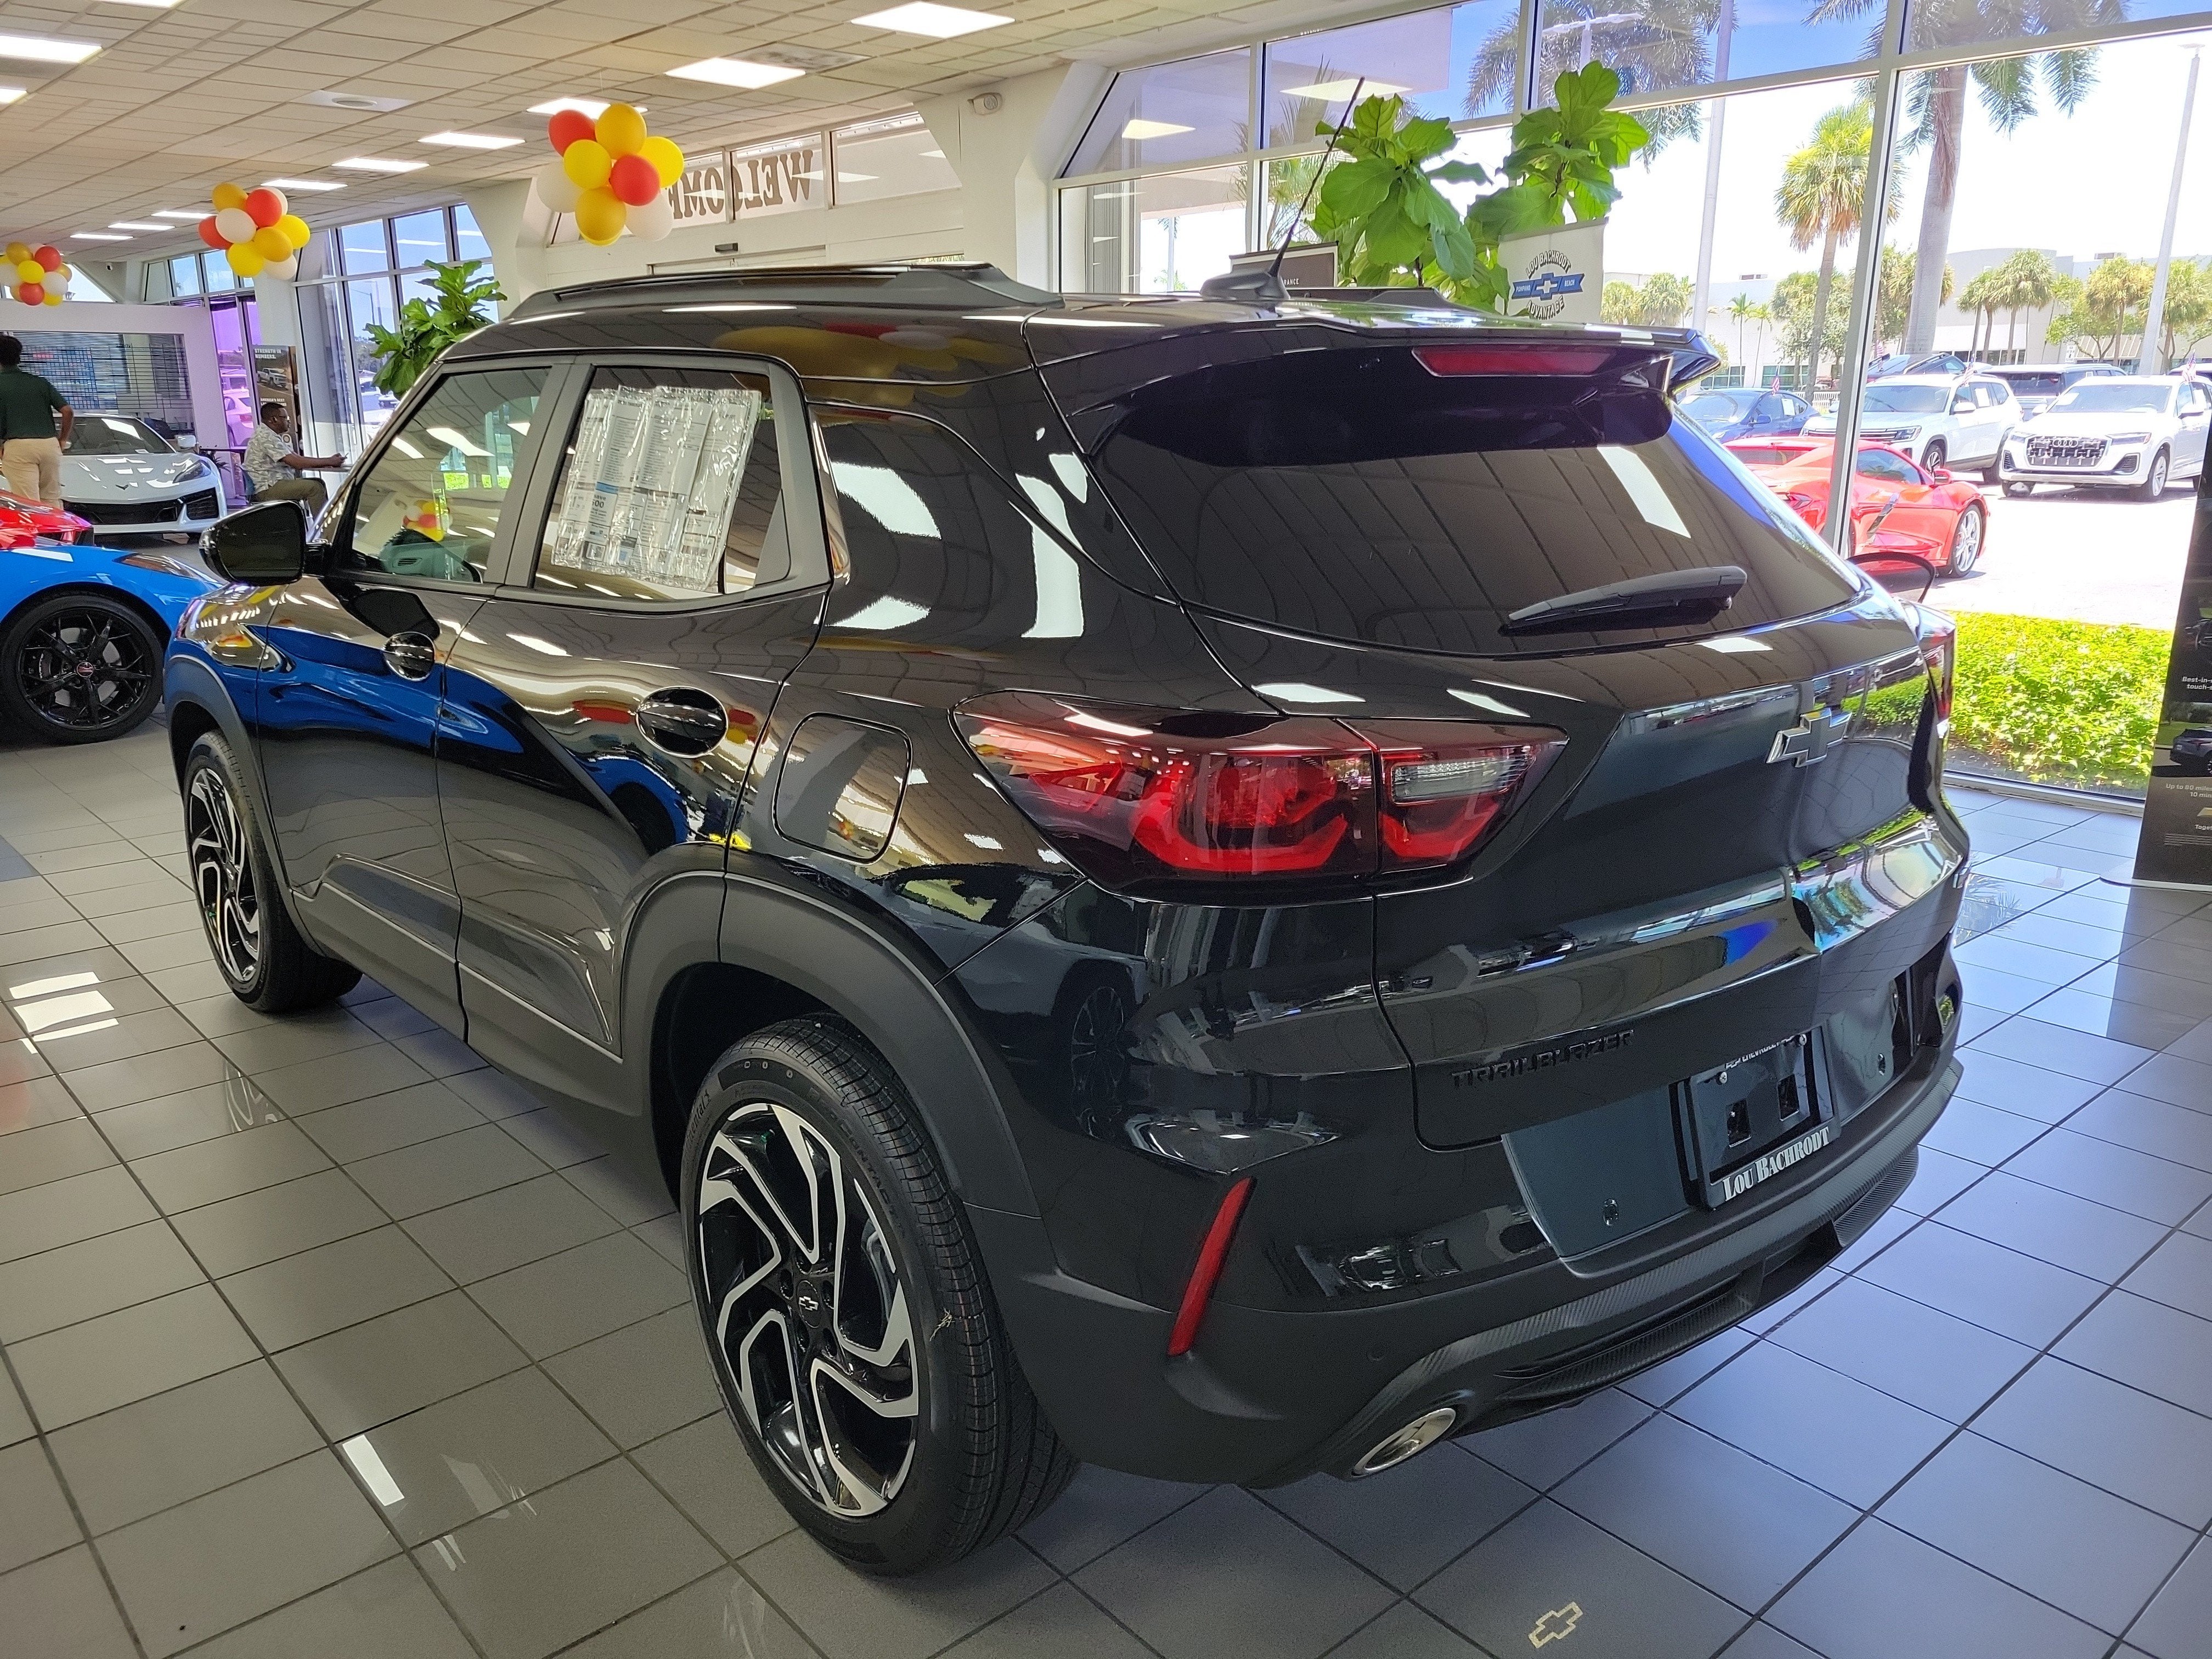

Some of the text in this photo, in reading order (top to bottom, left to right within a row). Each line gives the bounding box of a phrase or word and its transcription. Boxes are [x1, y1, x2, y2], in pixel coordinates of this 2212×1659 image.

[1526, 250, 1571, 279] LOU BACHRODT
[1564, 279, 1575, 287] BEACH
[1526, 295, 1565, 320] ADVANTAGE
[1451, 1029, 1634, 1088] TRAILBLAZER
[1722, 1126, 1830, 1201] LOU BACHRODT
